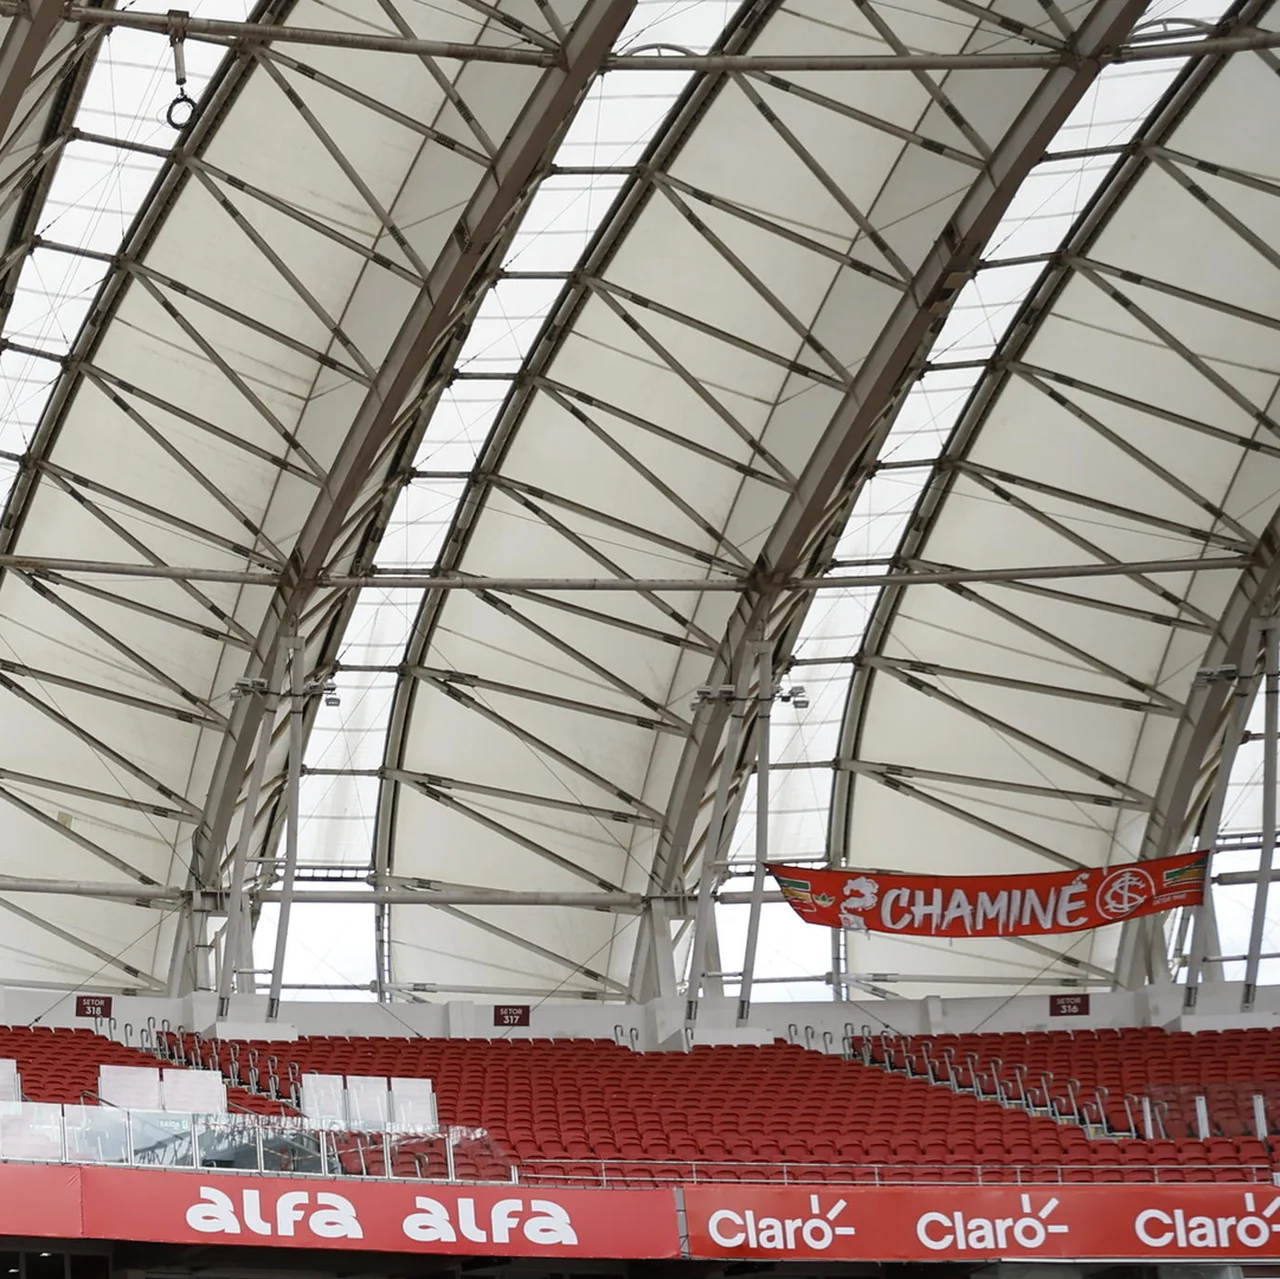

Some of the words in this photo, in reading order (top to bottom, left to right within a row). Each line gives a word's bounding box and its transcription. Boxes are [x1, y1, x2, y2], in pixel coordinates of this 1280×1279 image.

[82, 999, 105, 1007] SETOR
[1056, 997, 1082, 1005] SETOR
[85, 1006, 102, 1015] 318
[500, 1008, 523, 1016] SETOR
[1059, 1005, 1079, 1014] 316
[503, 1015, 520, 1024] 317
[708, 1209, 834, 1250] Claro
[916, 1210, 1047, 1250] Claro
[1134, 1208, 1270, 1248] Claro
